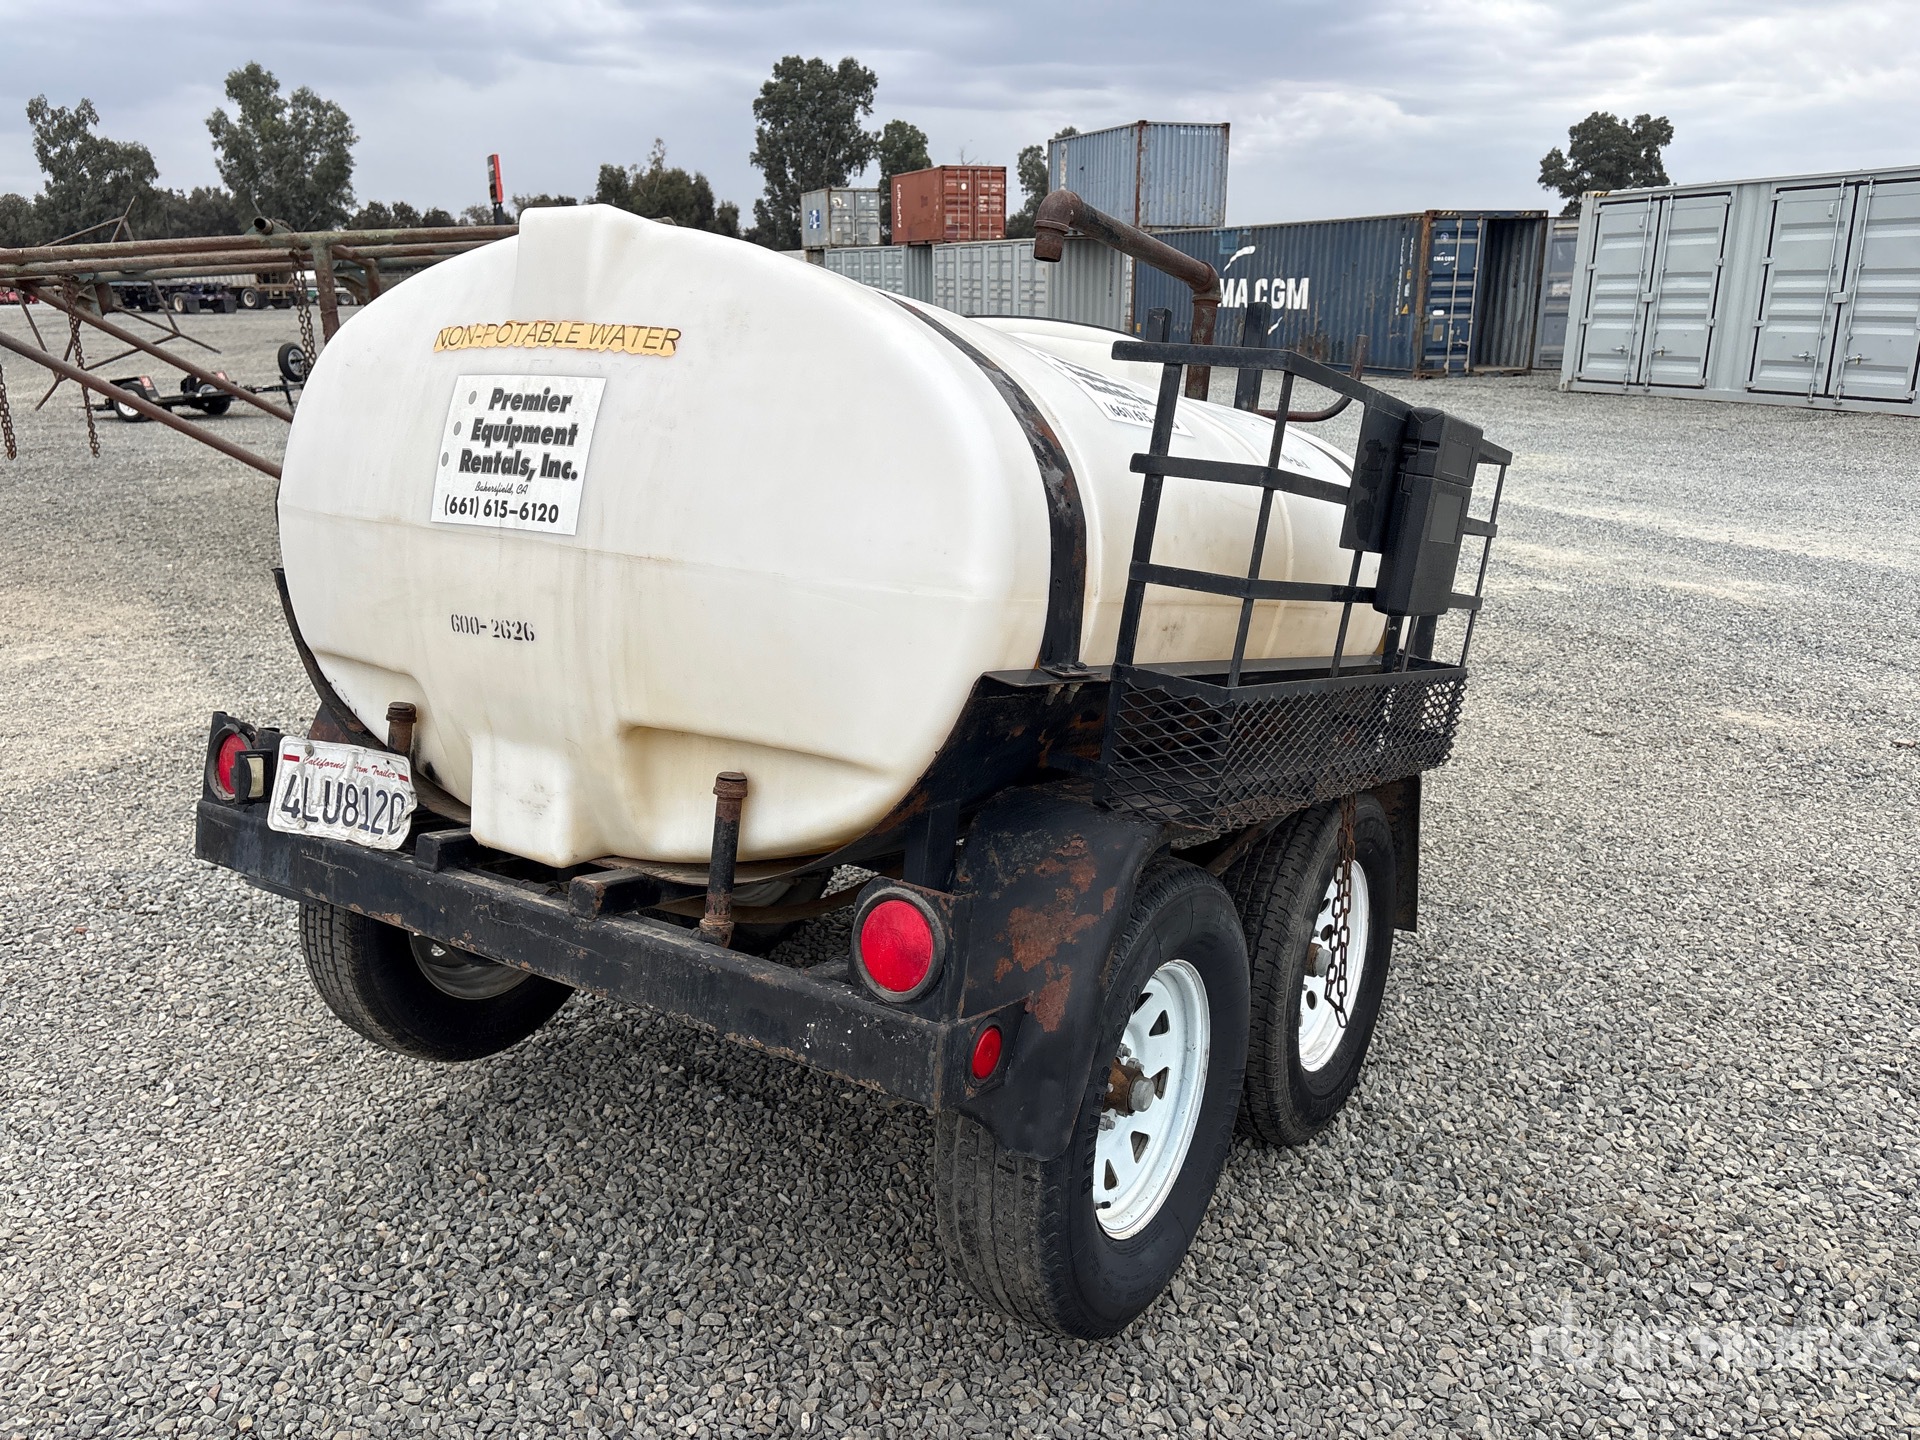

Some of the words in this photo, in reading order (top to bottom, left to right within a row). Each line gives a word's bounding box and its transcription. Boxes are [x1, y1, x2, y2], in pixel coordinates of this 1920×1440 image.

[1217, 278, 1247, 308] MA
[1254, 278, 1309, 309] CGM
[435, 322, 584, 349] NON-POTABLE
[589, 323, 681, 352] WATER
[488, 386, 573, 413] Premier
[470, 416, 578, 448] Equipment
[458, 448, 537, 481] Rentals,
[540, 453, 578, 480] Inc.
[475, 481, 513, 496] Bakersfield,
[516, 484, 528, 494] CA
[444, 494, 479, 518] (661)
[483, 499, 559, 523] 615-6120
[451, 614, 535, 641] 600-2626
[371, 765, 396, 779] Trailer
